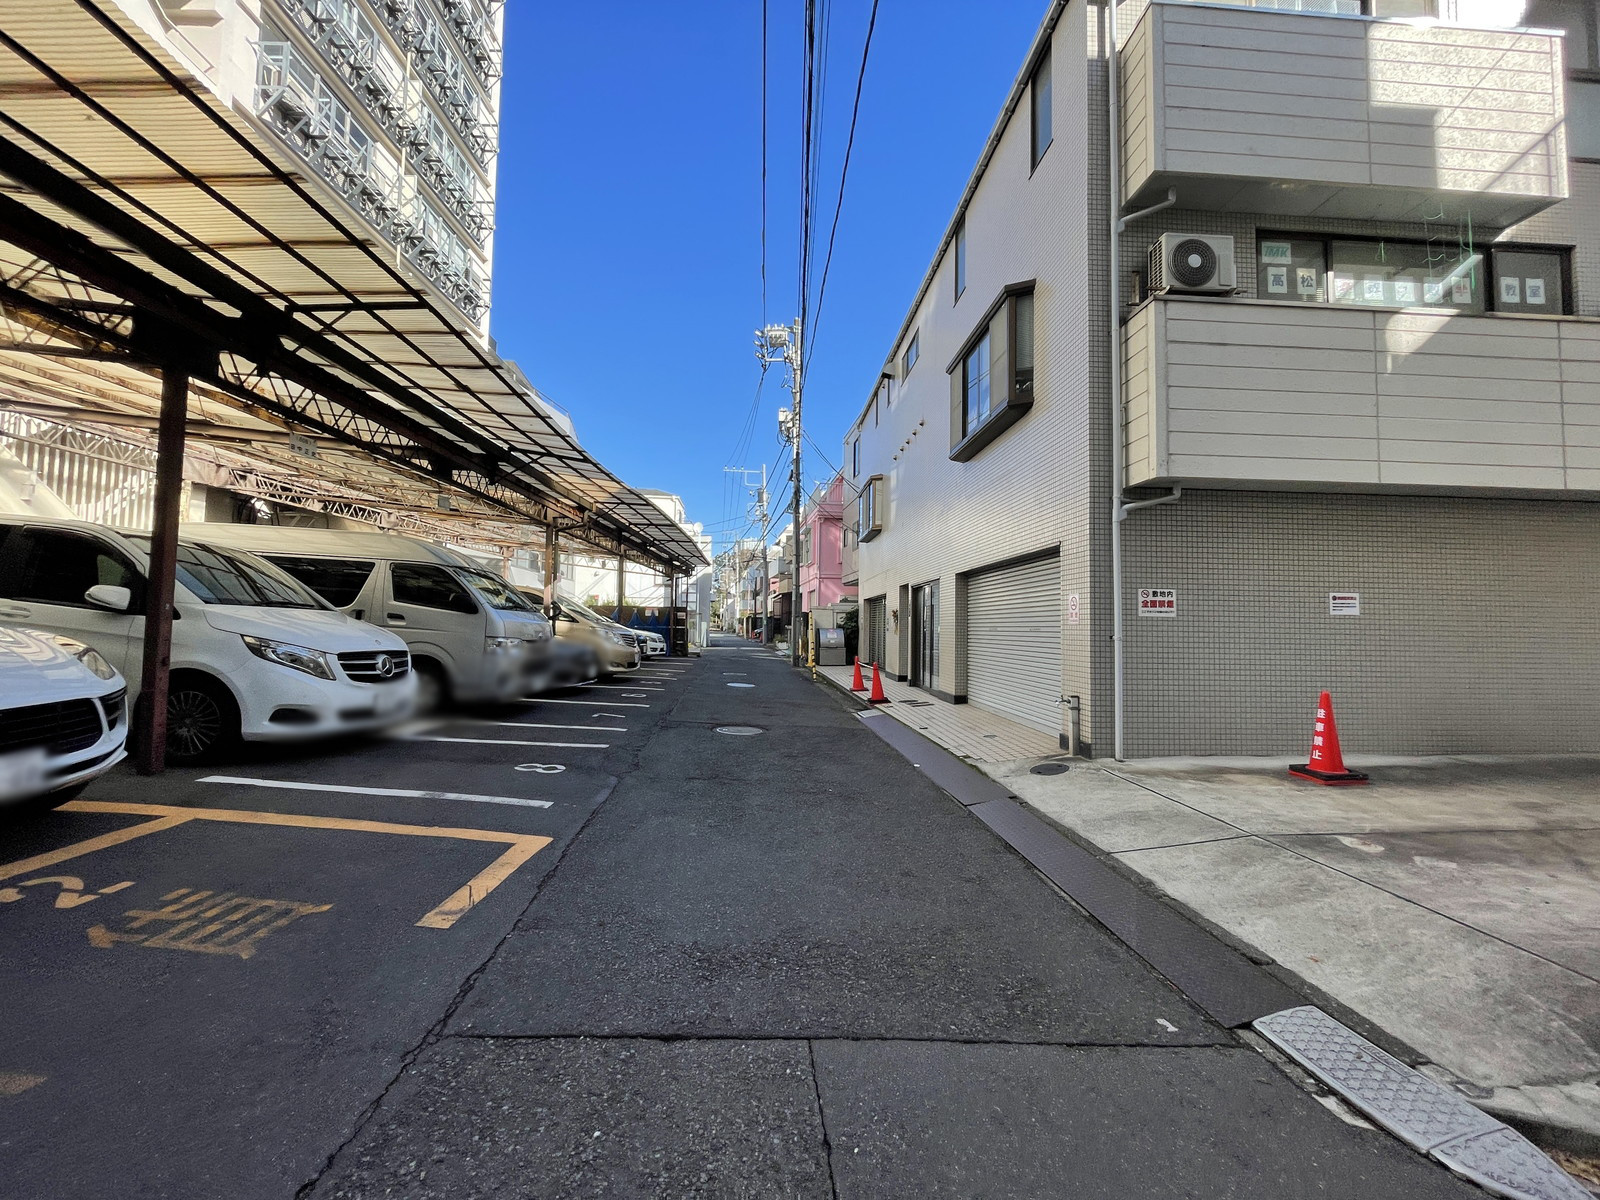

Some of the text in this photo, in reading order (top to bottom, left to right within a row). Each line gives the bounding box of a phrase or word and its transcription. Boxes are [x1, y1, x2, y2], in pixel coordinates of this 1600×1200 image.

[1263, 245, 1289, 258] TMK
[1151, 590, 1174, 598] 敷地内
[1141, 599, 1175, 608] 全面禁煙
[1311, 708, 1327, 760] 駐車禁止
[513, 762, 567, 774] 8
